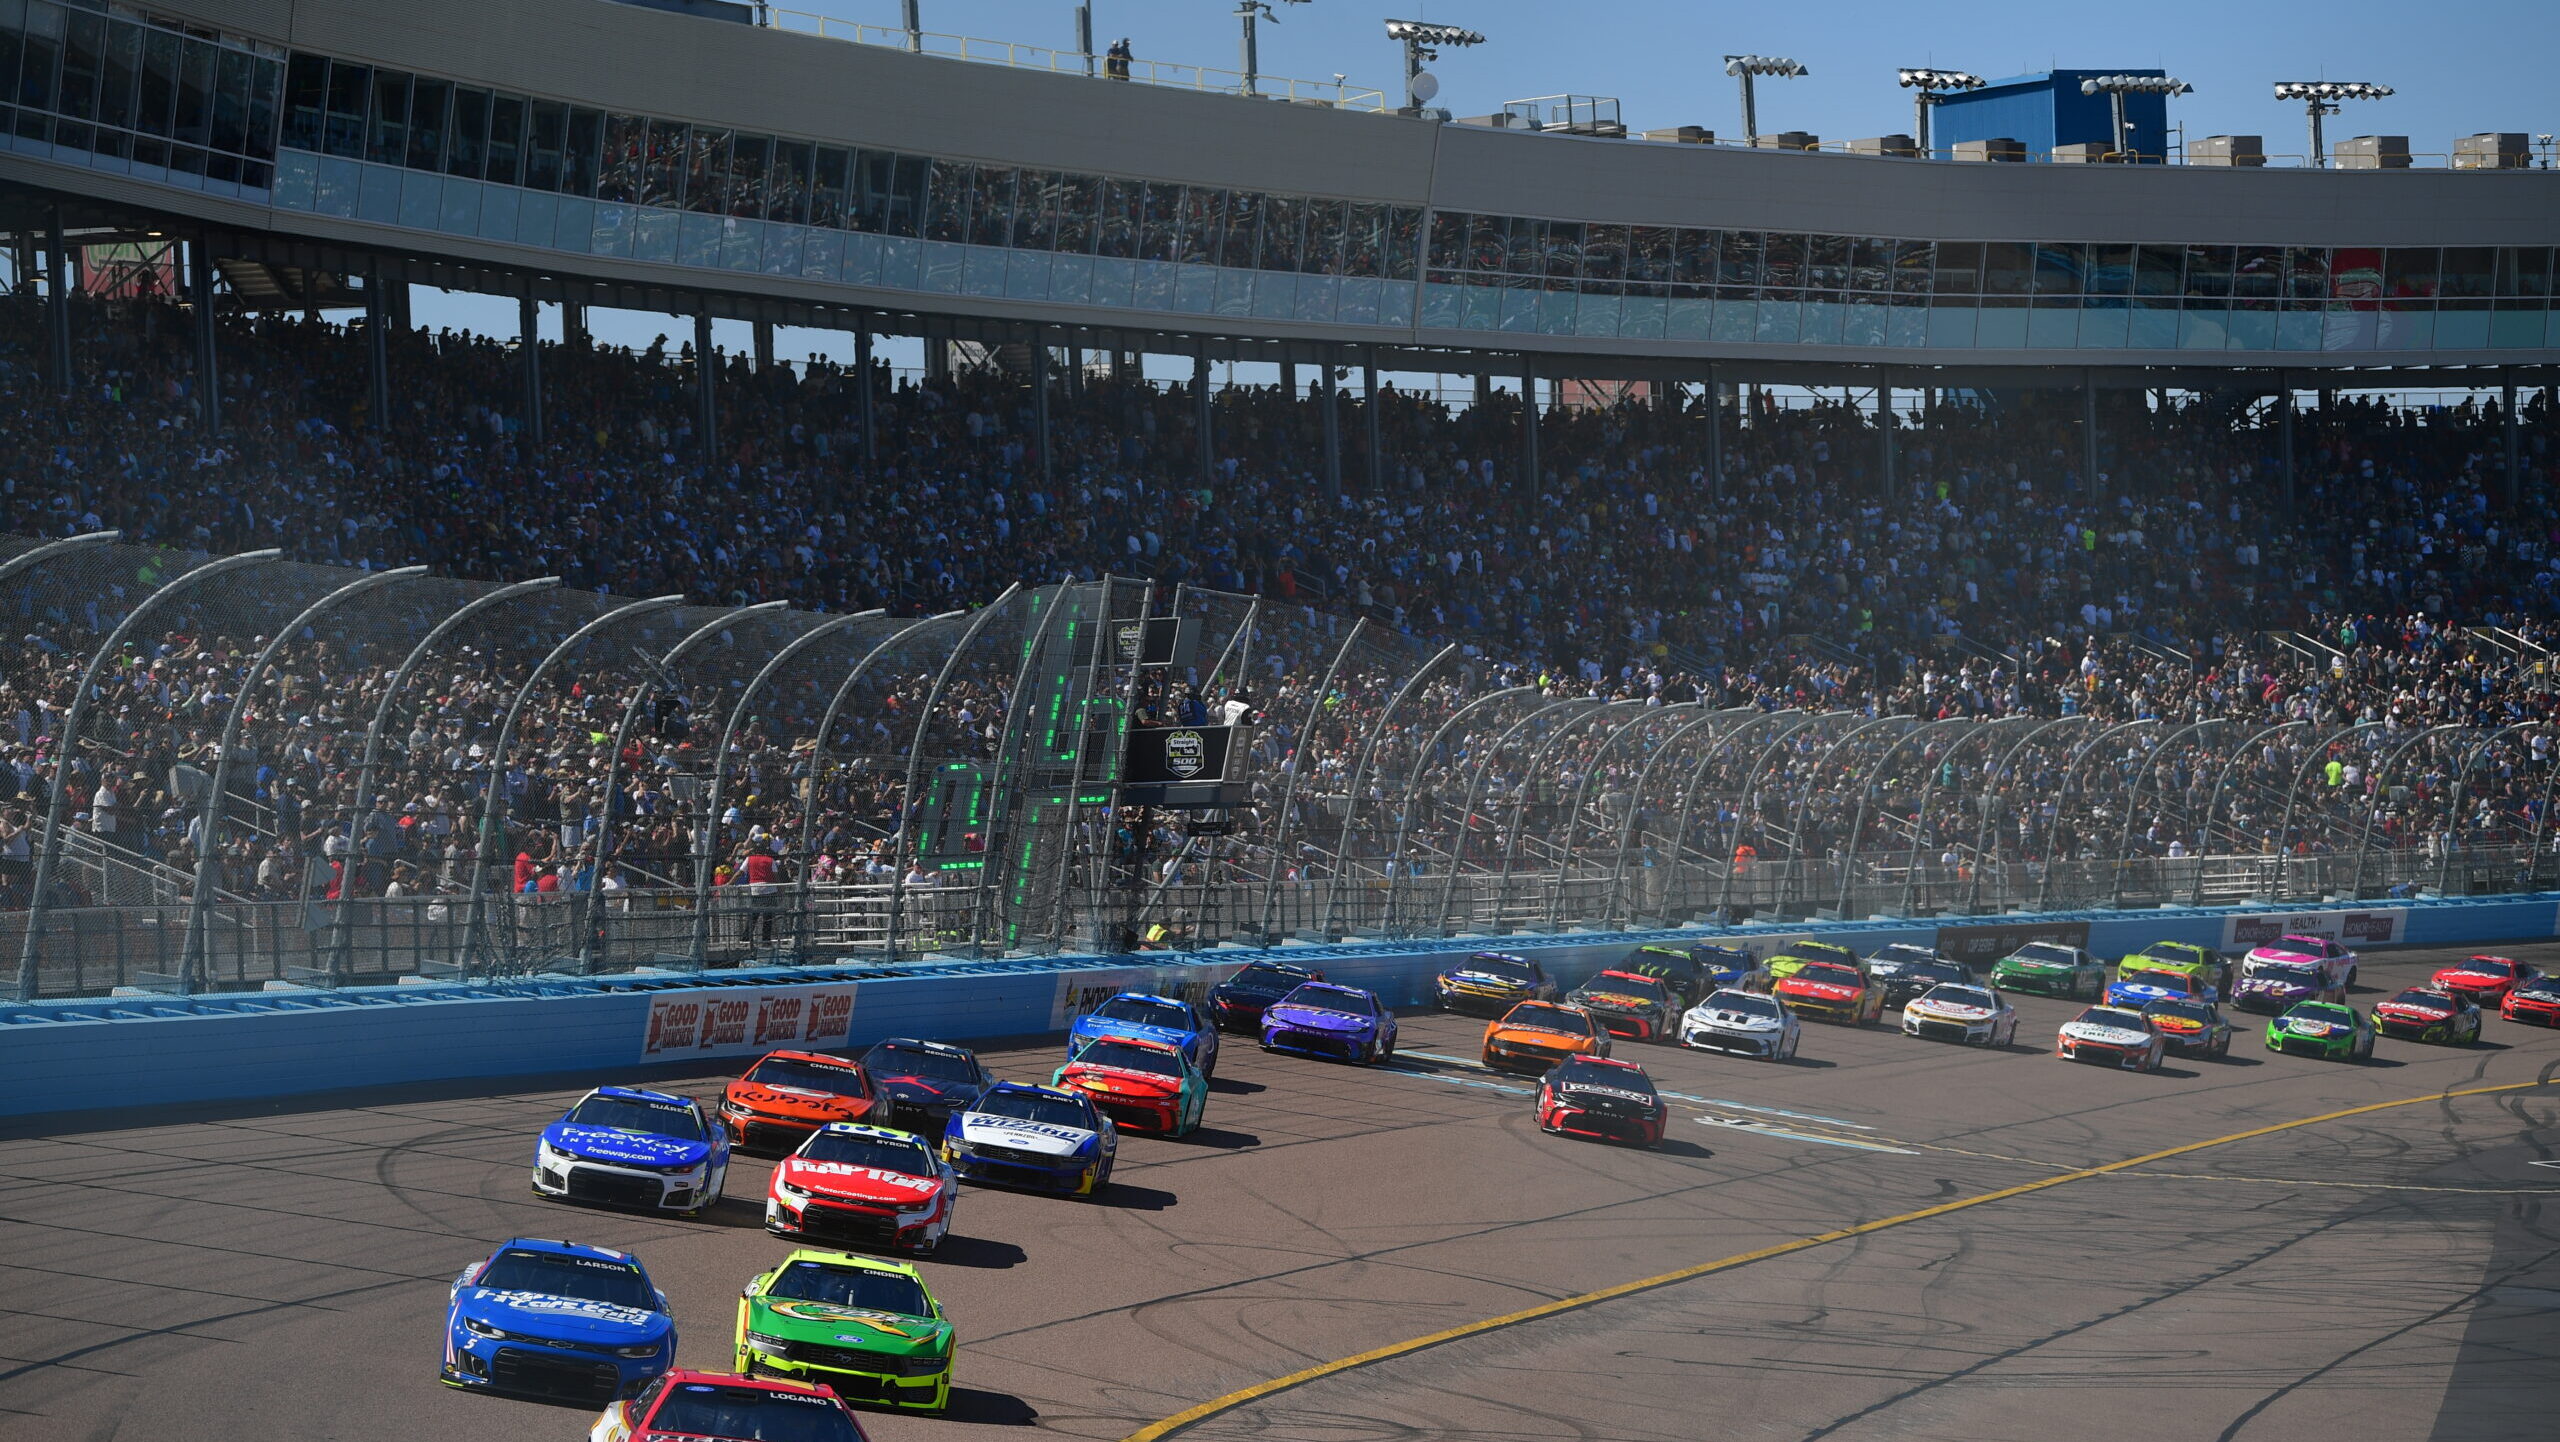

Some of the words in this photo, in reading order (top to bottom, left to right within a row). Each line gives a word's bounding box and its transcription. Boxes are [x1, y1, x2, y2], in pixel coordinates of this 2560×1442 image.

[1173, 757, 1197, 765] 500
[2289, 916, 2317, 929] HEALTH
[2346, 918, 2391, 934] HONORHEALTH
[719, 1001, 749, 1022] GOOD
[773, 999, 801, 1020] GOOD
[823, 995, 851, 1016] GOOD
[666, 1004, 698, 1027] GOOD
[1140, 1046, 1172, 1056] HAMLIN
[810, 1062, 855, 1074] CHASTAIN
[733, 1090, 855, 1121] Kubota
[1042, 1094, 1073, 1104] BLANEY
[1095, 1093, 1136, 1103] CAMRY
[1588, 1109, 1624, 1119] CAMRY
[971, 1116, 1081, 1139] WIZARD
[562, 1127, 690, 1154] Freeway
[876, 1138, 910, 1148] BYRON
[559, 1137, 688, 1161] INSURANCE
[586, 1145, 656, 1162] Freeway.com
[790, 1158, 936, 1194] RAPTOR
[814, 1183, 897, 1201] RaptorCoatings.com
[576, 1258, 626, 1272] LARSON
[863, 1268, 905, 1280] CINDRIC
[464, 1338, 478, 1349] 5
[758, 1353, 768, 1363] 2
[770, 1390, 827, 1406] LOGANO
